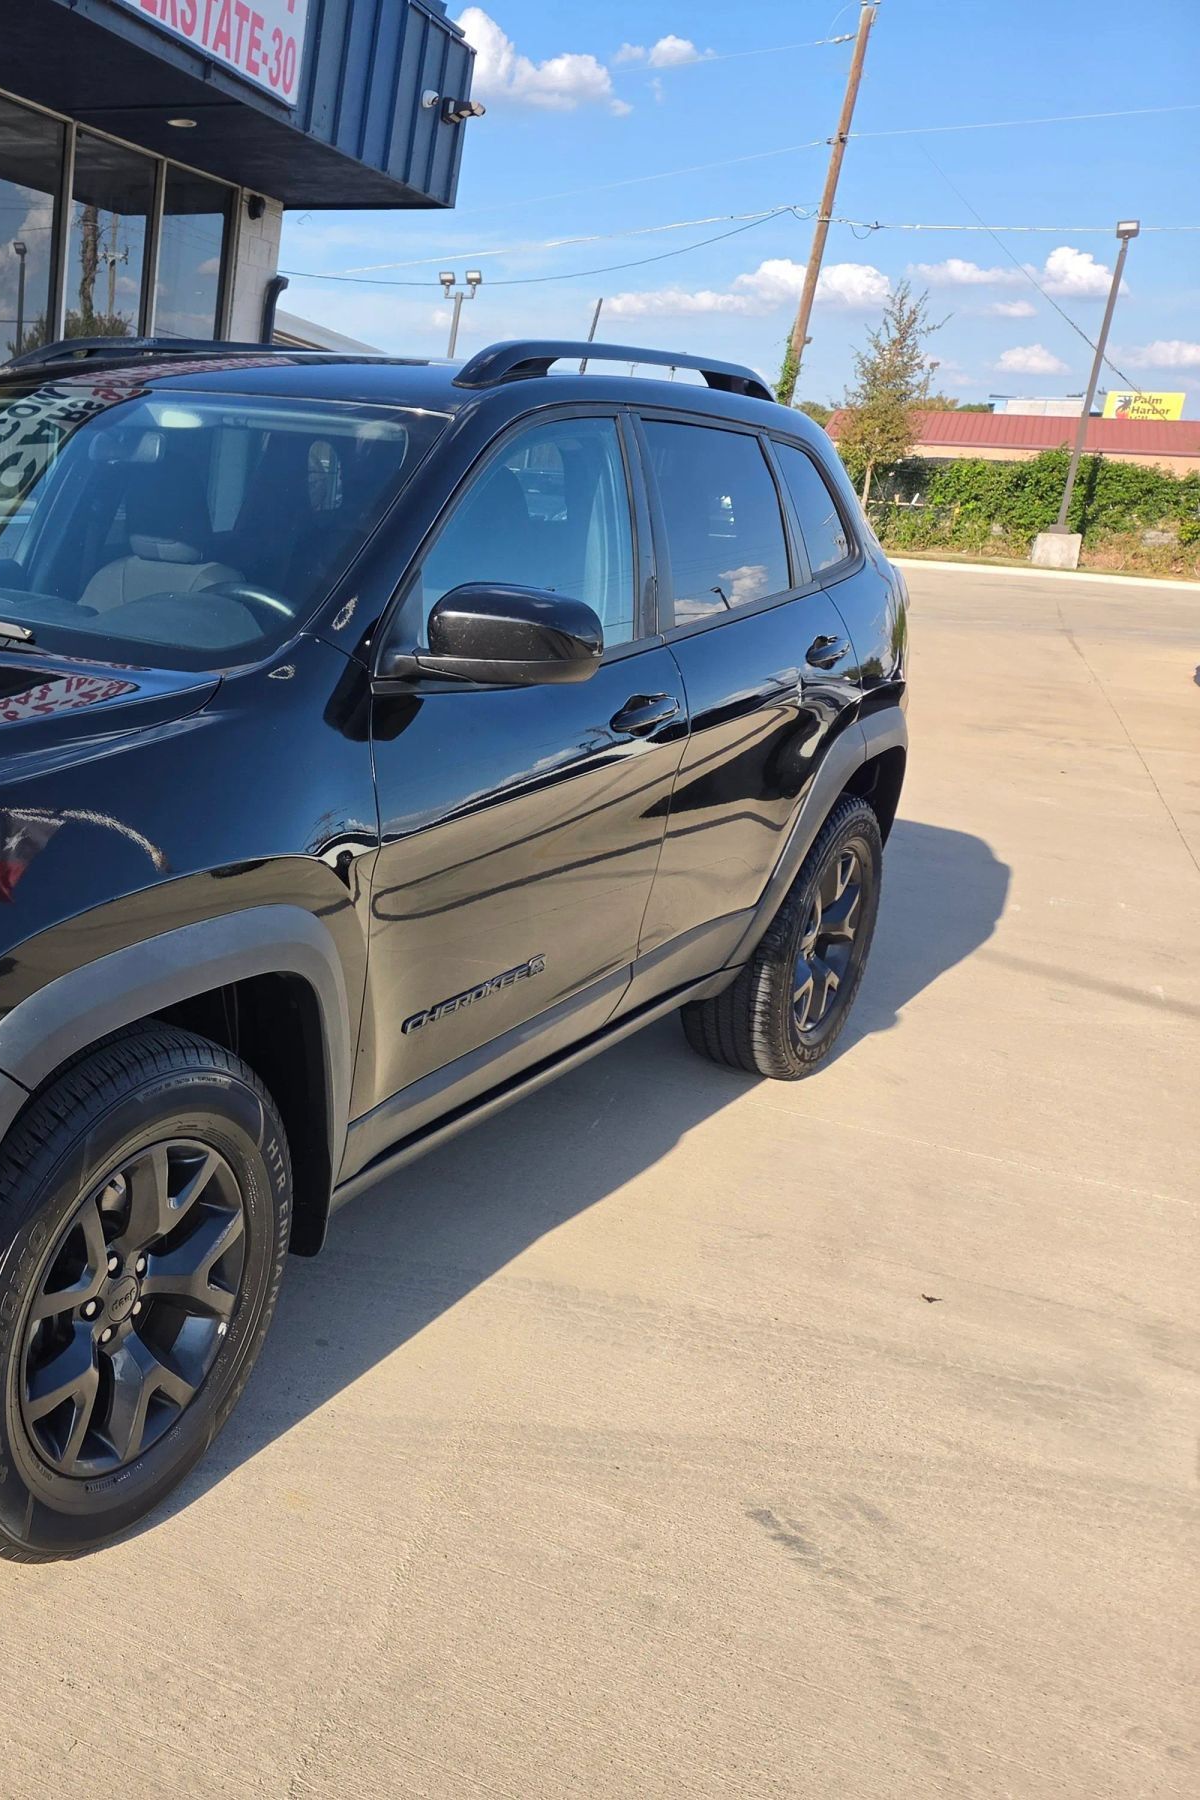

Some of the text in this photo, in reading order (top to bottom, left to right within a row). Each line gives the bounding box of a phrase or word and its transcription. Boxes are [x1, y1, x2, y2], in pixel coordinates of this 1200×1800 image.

[140, 0, 297, 95] STATE-30
[1131, 405, 1171, 415] Harbor
[1133, 395, 1163, 405] Palm
[400, 963, 530, 1036] CHEROKEE
[266, 1138, 288, 1193] HTR
